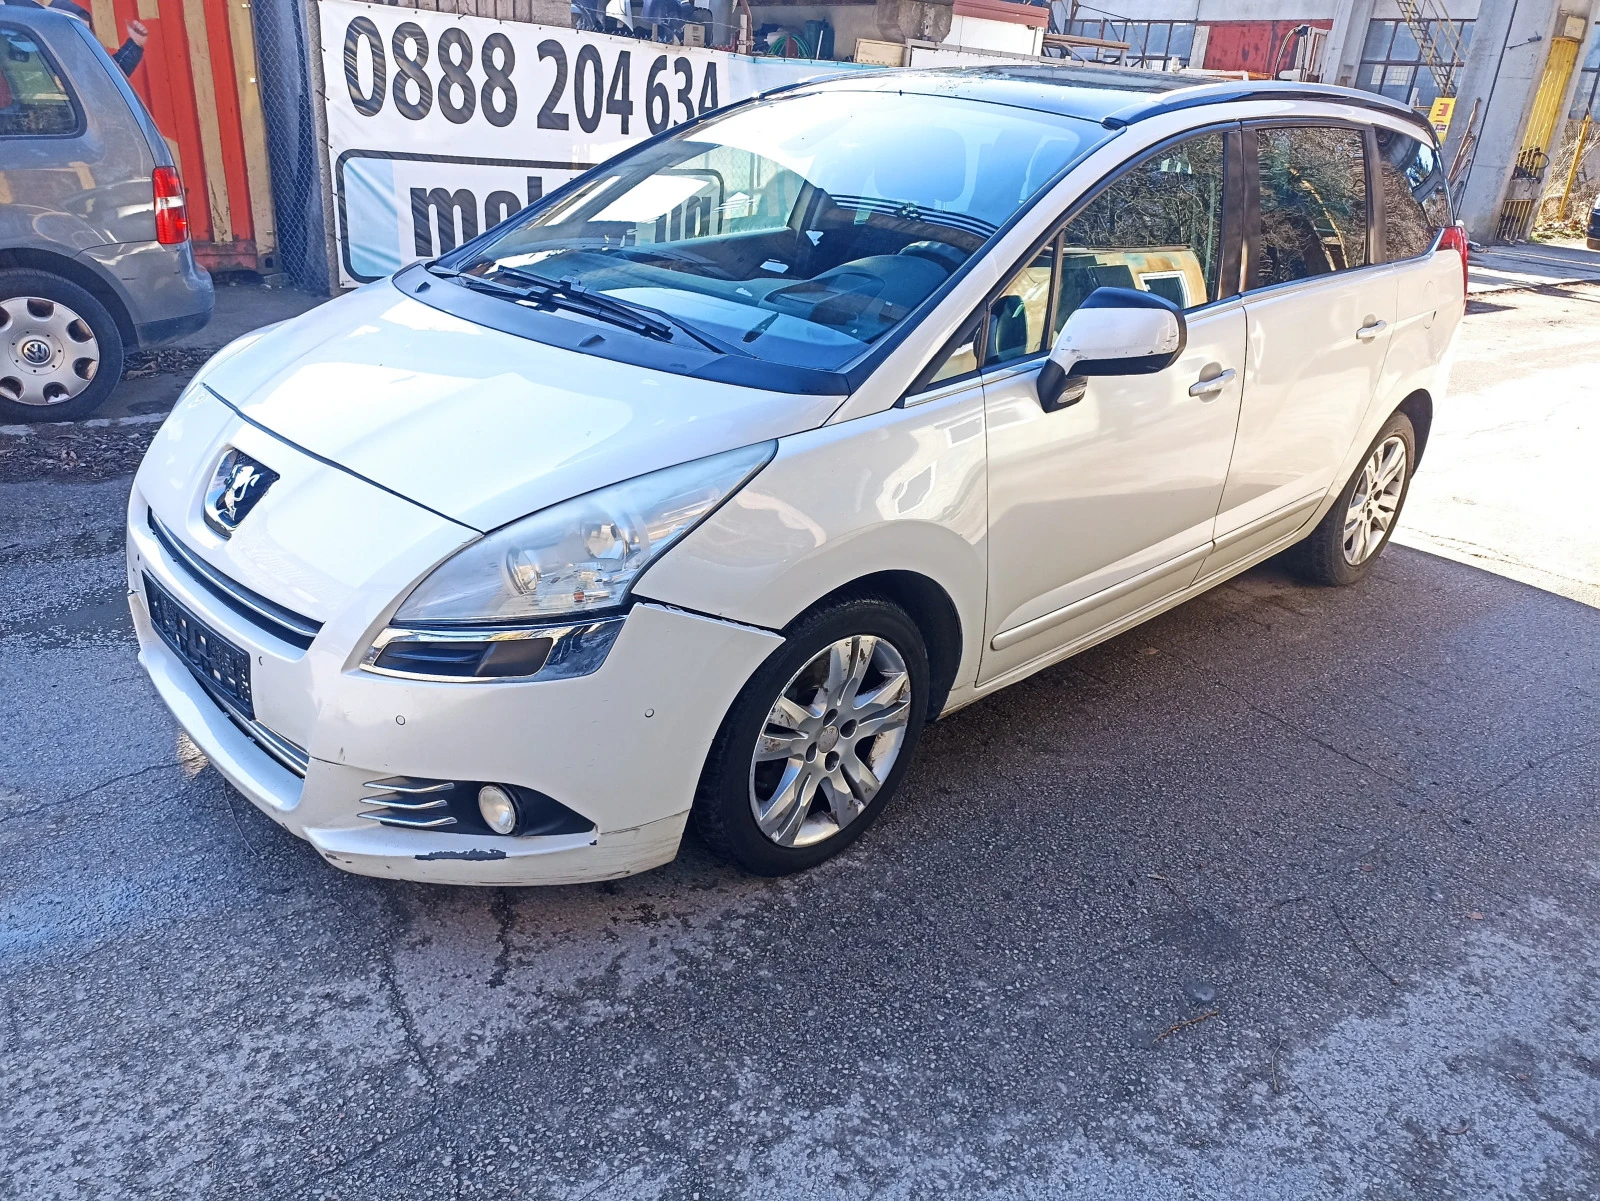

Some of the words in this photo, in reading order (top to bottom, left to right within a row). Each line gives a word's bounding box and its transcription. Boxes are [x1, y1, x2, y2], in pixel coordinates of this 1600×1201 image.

[344, 16, 517, 127] 0888
[537, 39, 633, 135] 204
[645, 54, 719, 136] 634
